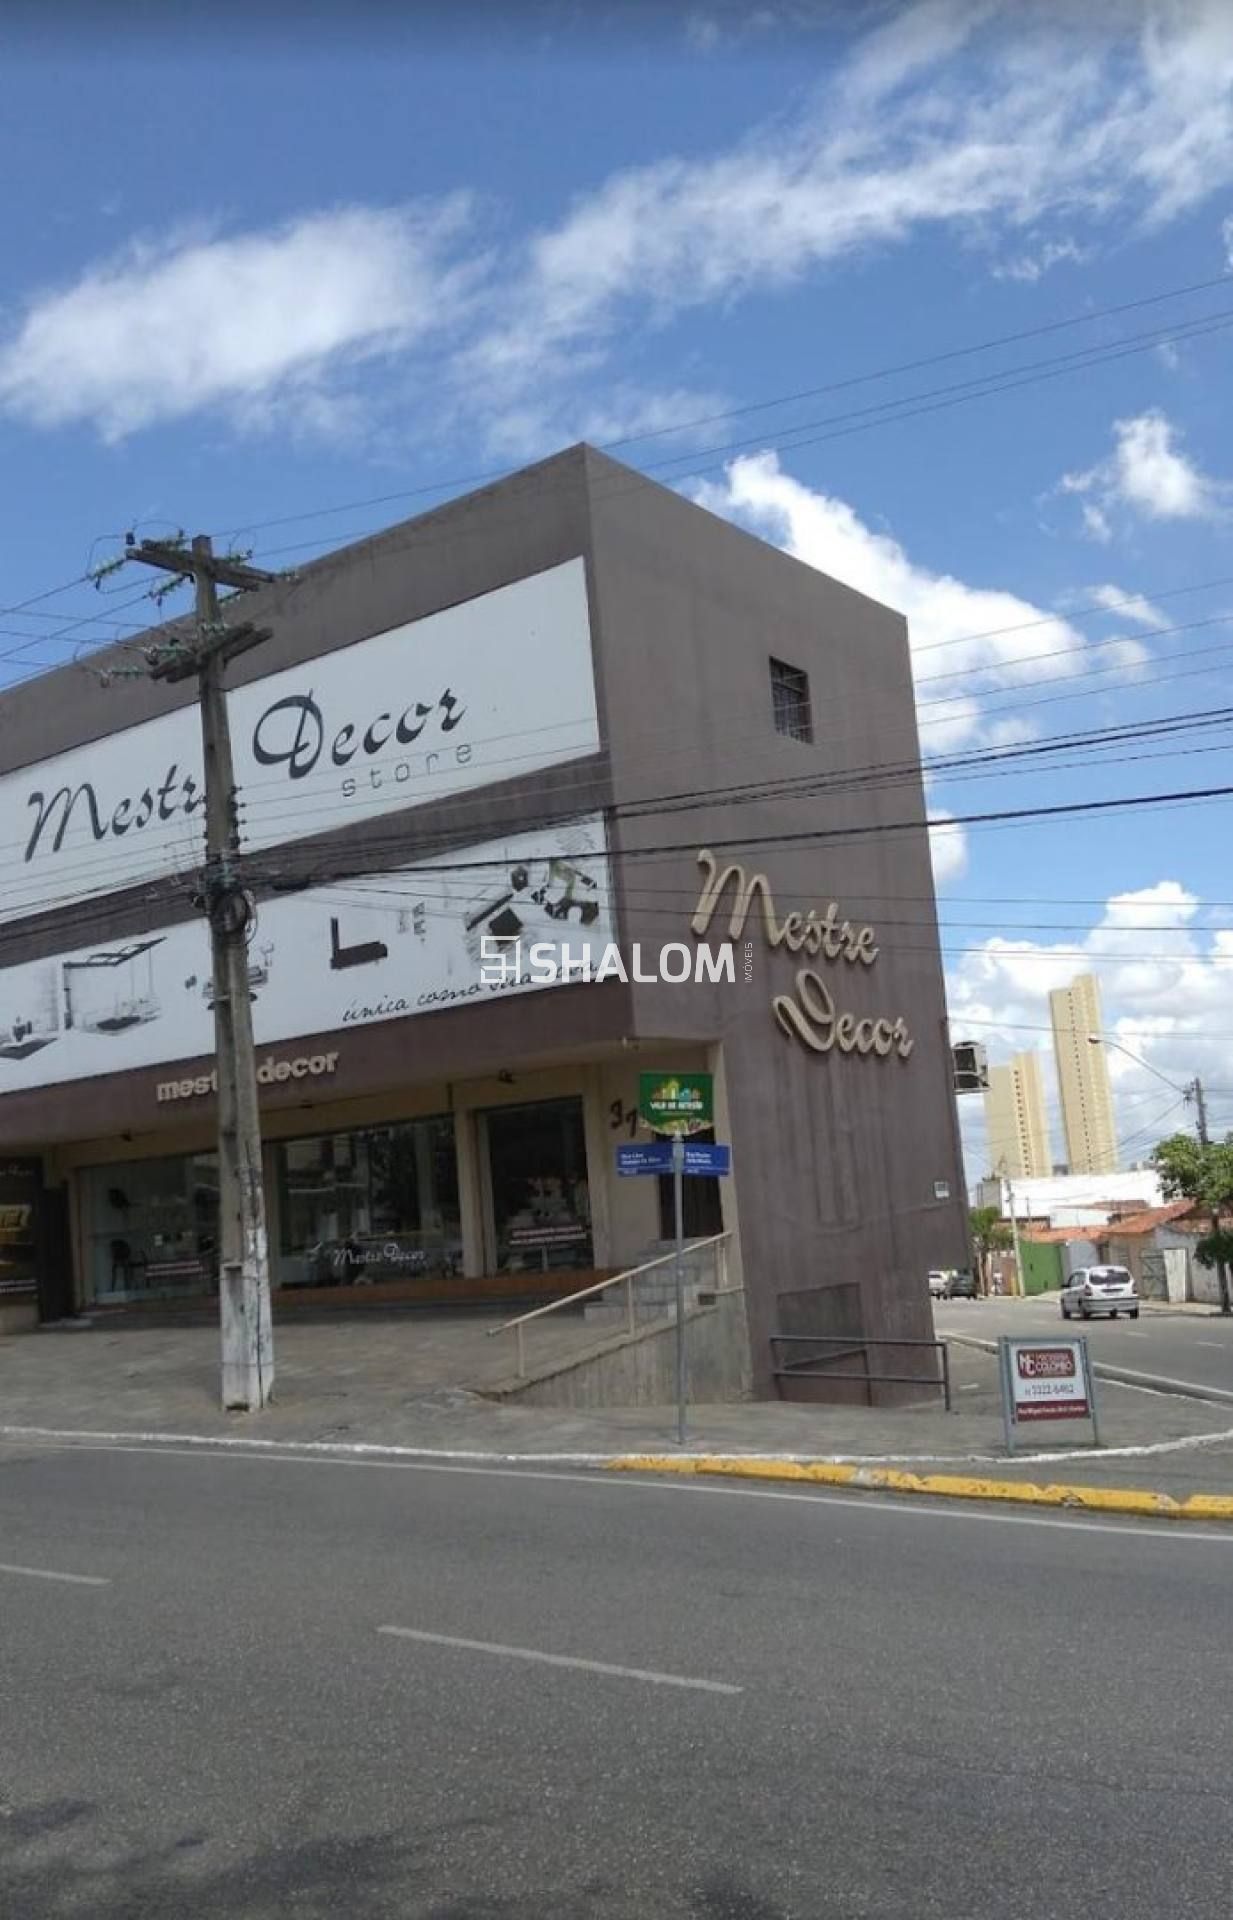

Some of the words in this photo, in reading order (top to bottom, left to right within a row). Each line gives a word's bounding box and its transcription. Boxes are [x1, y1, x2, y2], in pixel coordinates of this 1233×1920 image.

[252, 687, 469, 779] Decor
[341, 742, 474, 798] store
[691, 849, 879, 964] Mestre
[342, 993, 409, 1022] única
[416, 982, 482, 1005] como
[772, 968, 915, 1059] Decor
[156, 1069, 219, 1102] mest
[256, 1051, 340, 1084] decor
